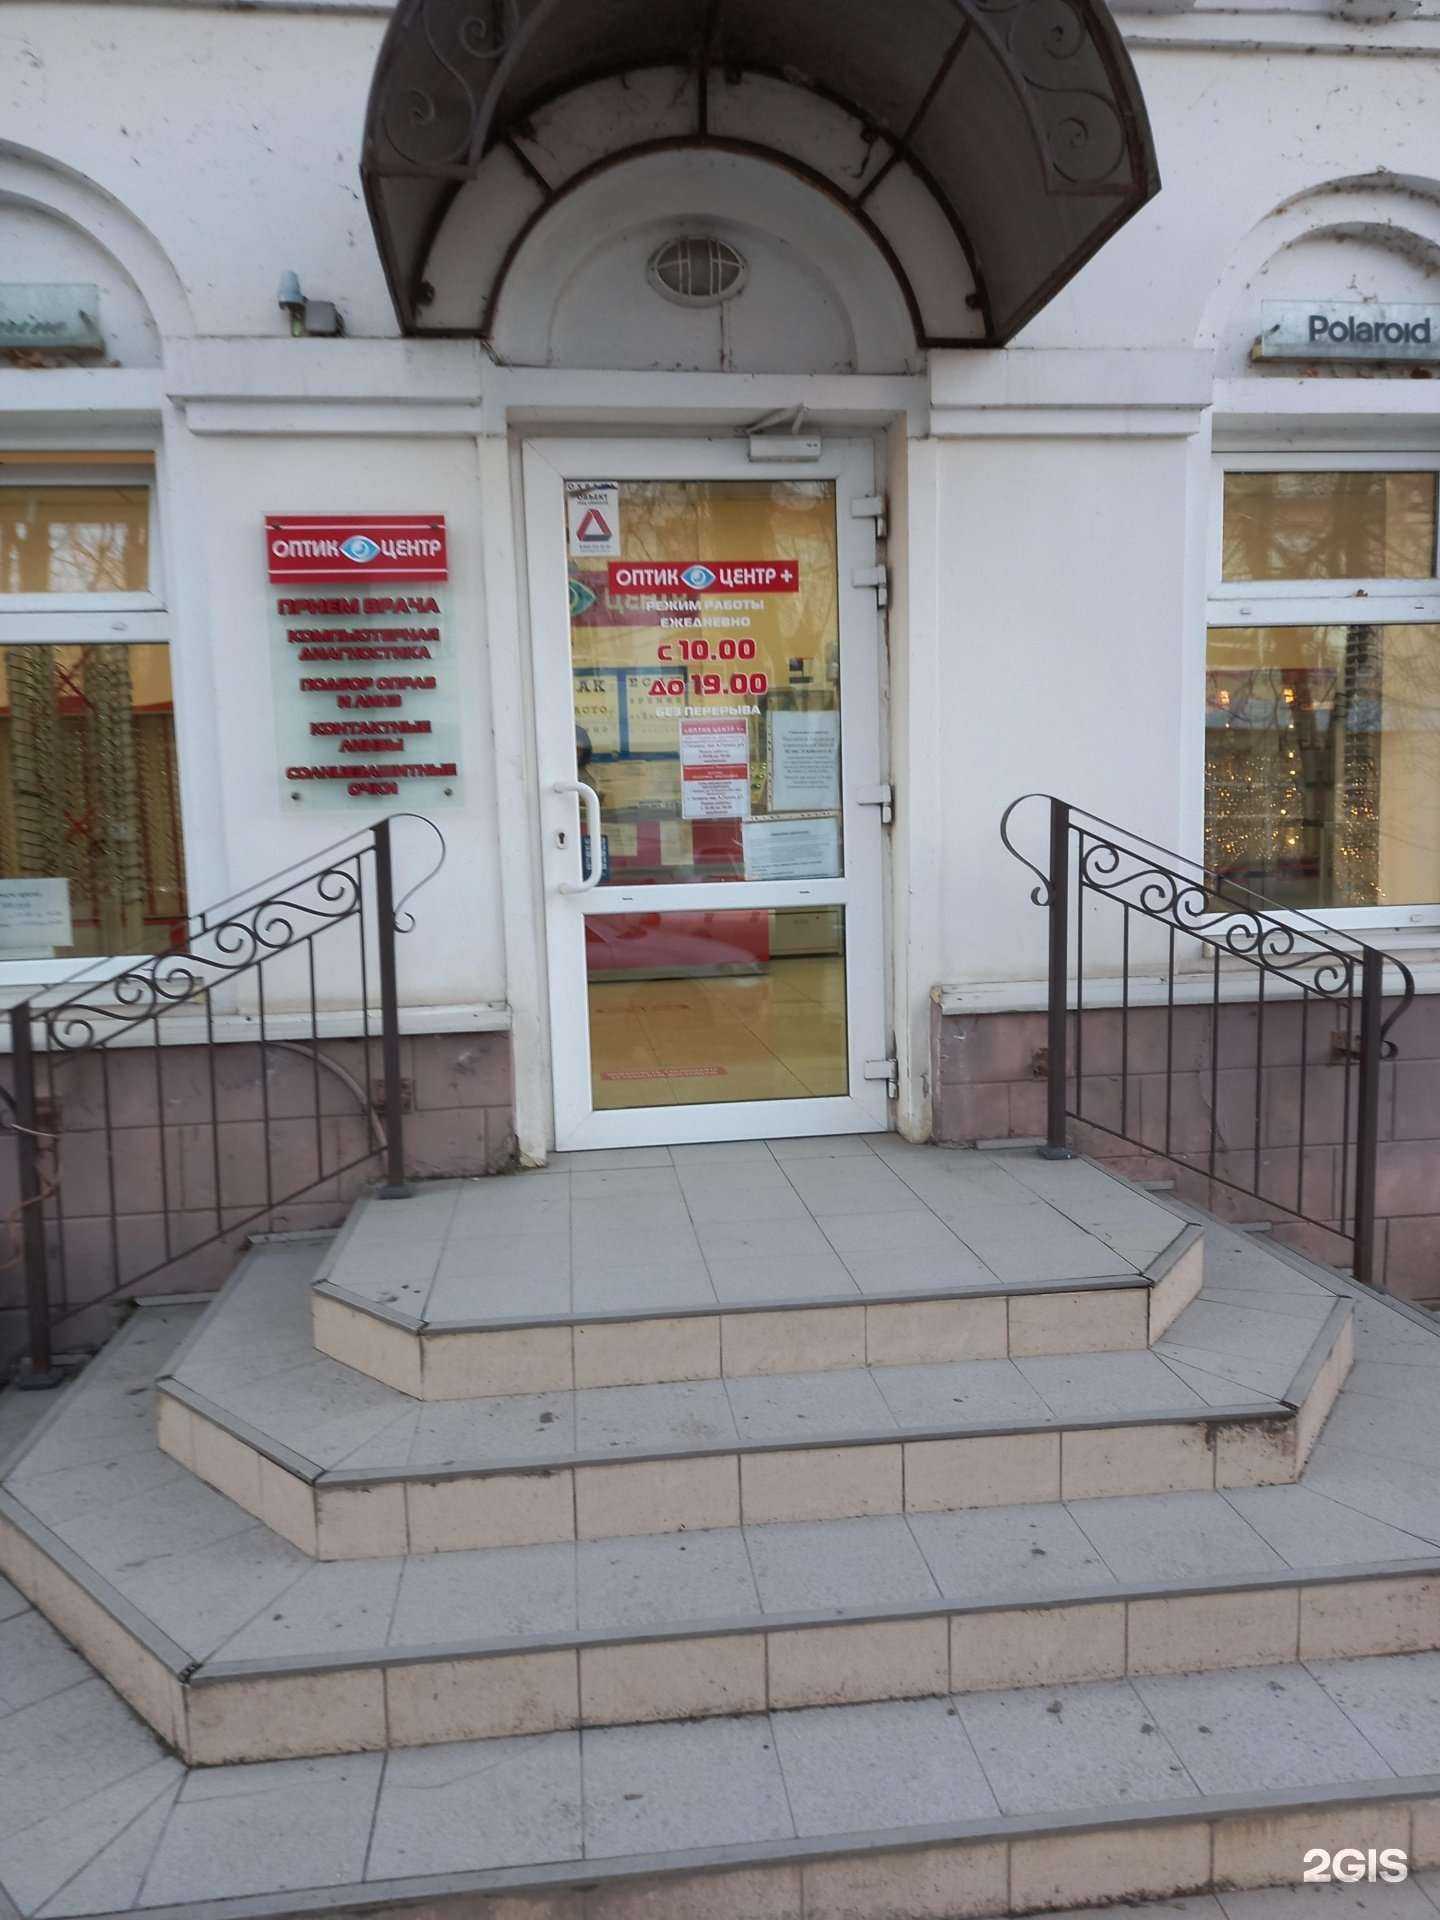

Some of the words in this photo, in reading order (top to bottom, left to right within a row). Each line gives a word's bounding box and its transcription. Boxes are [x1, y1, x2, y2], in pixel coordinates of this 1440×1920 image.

[1308, 314, 1431, 344] Polaroid
[272, 539, 340, 558] ОПТИК
[381, 538, 442, 560] ЦЕНТР
[616, 568, 679, 587] ОПТИК
[719, 567, 777, 588] ЦЕНТР
[644, 599, 702, 612] РЕЖИМ
[704, 598, 765, 611] РАБОТЫ
[660, 616, 751, 629] ЕЖЕДНЕВНО
[678, 639, 756, 661] 10.00
[690, 673, 767, 695] 19.00
[684, 704, 761, 717] ПЕРЕРЫВА
